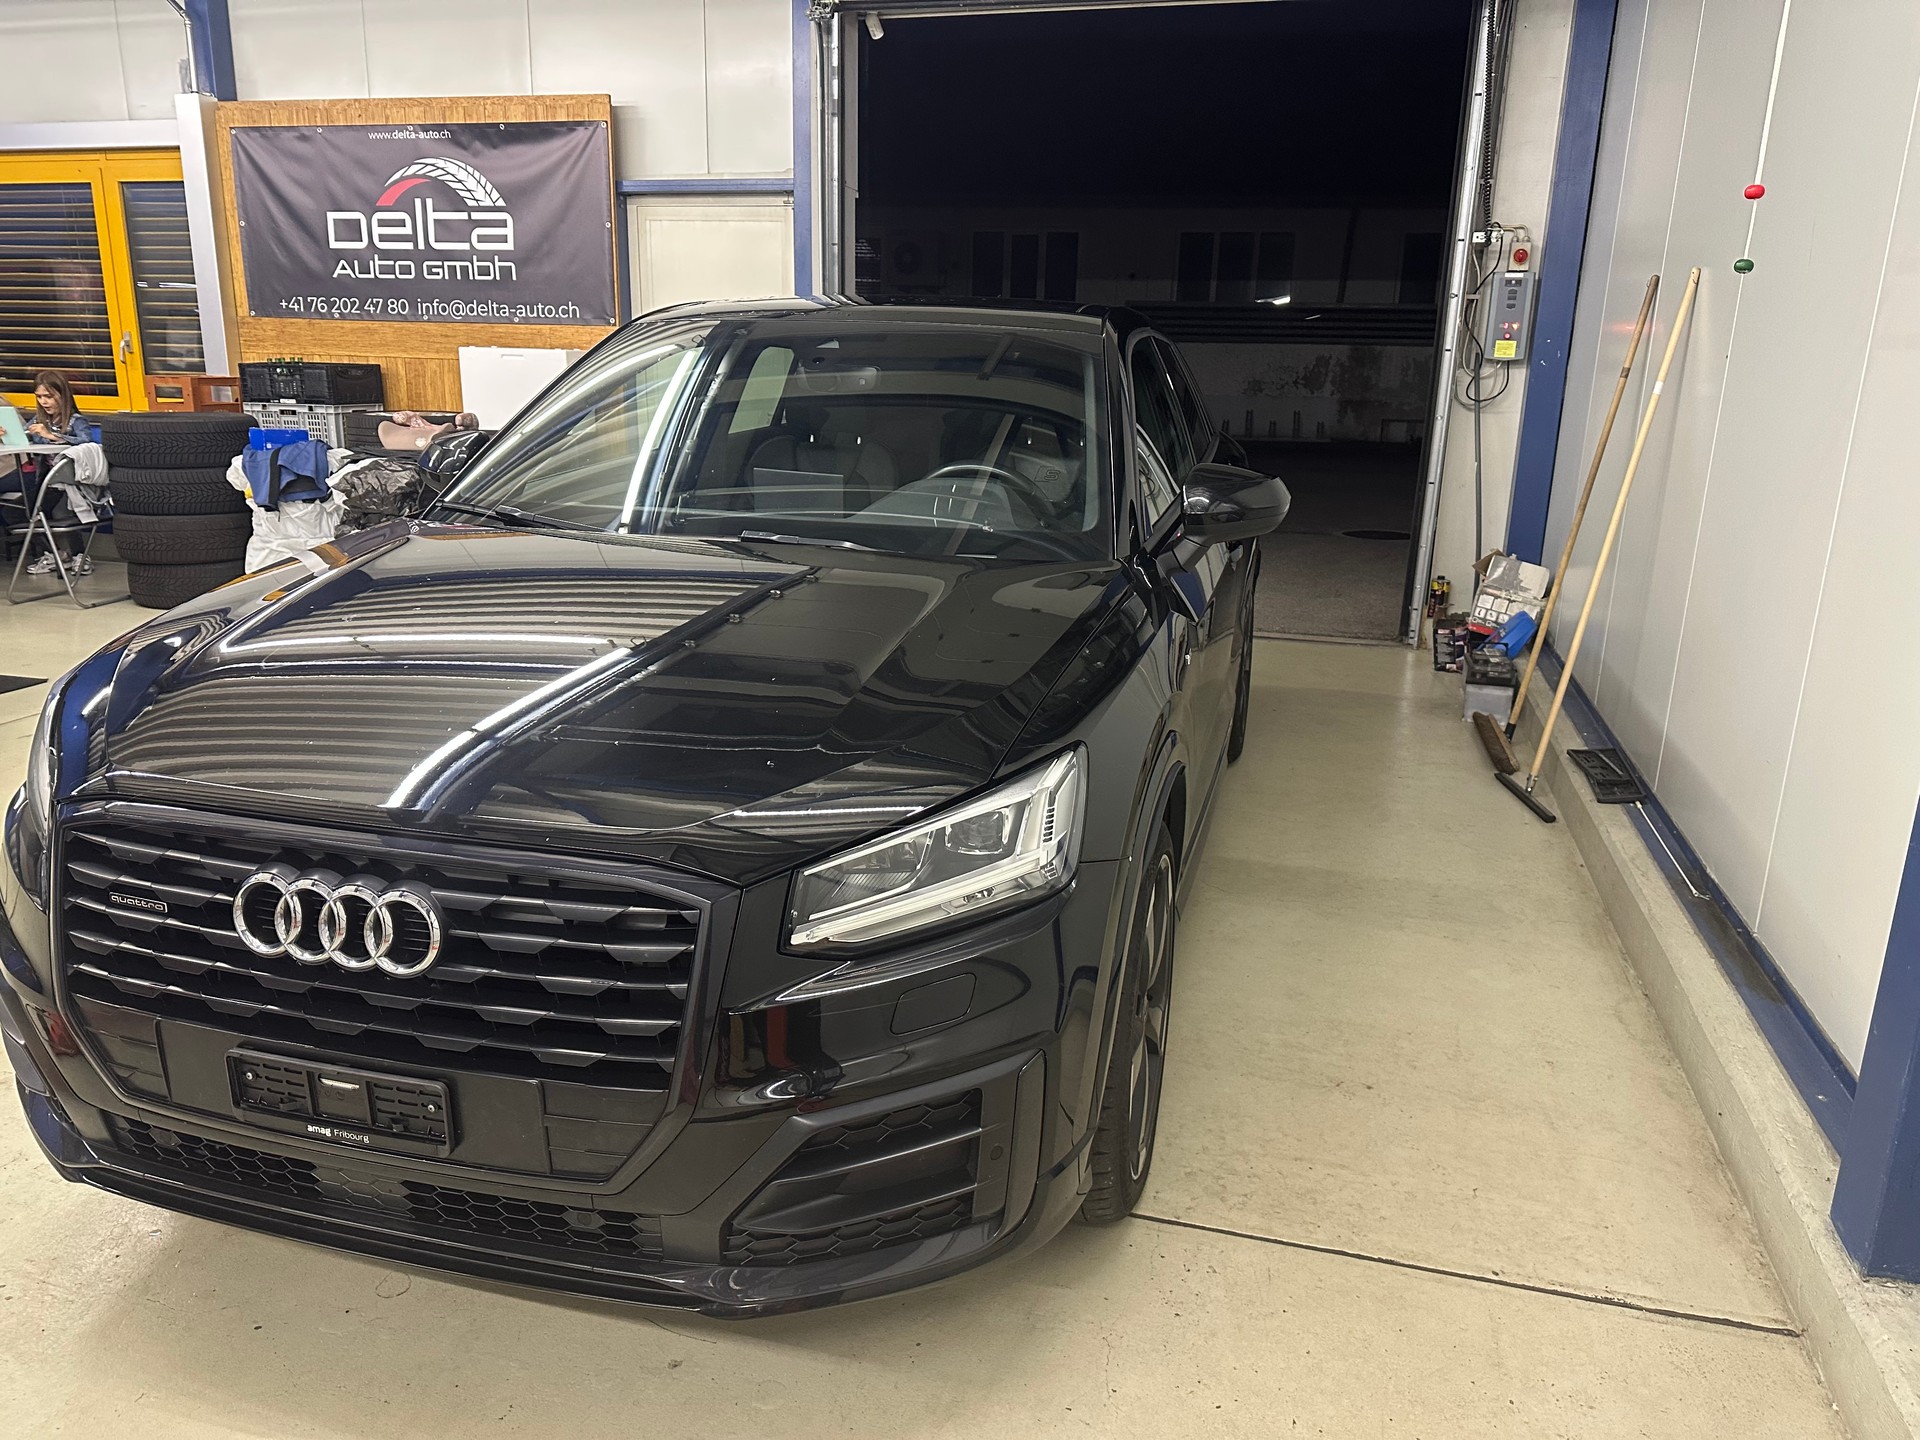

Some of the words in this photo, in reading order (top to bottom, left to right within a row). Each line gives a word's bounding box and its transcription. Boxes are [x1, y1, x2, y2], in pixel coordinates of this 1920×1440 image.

[368, 129, 452, 140] www.delta-auto.ch
[279, 296, 304, 313] +41
[307, 296, 328, 313] 76
[330, 297, 361, 314] 202
[363, 298, 384, 315] 47
[387, 298, 409, 315] 80
[417, 299, 581, 320] info@delta-auto.ch
[111, 895, 164, 911] quattro
[307, 1124, 332, 1137] amag
[333, 1128, 370, 1144] Fribourg
